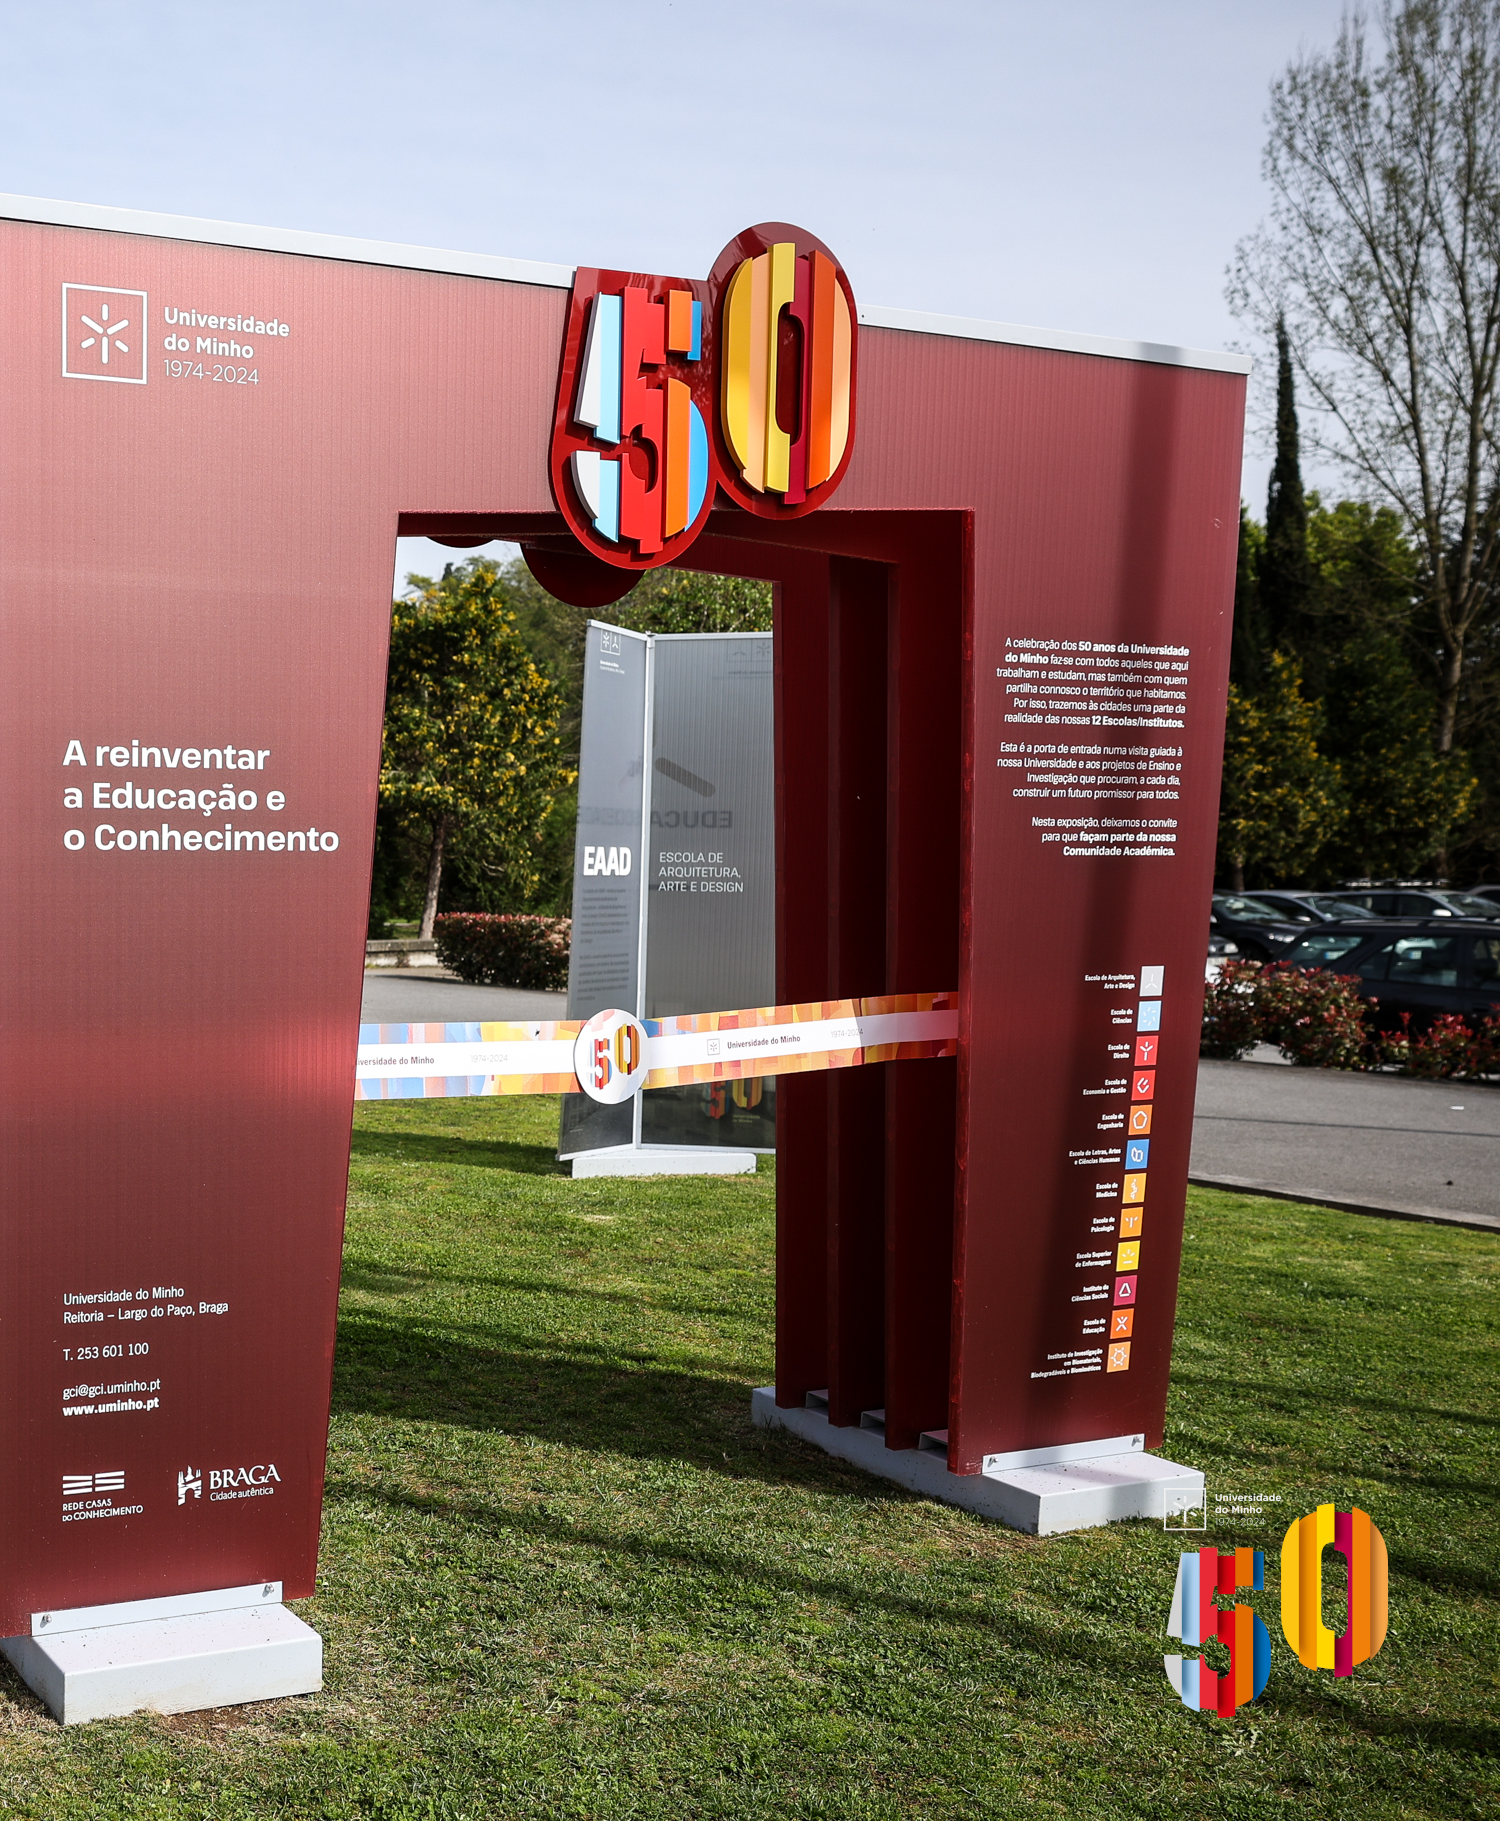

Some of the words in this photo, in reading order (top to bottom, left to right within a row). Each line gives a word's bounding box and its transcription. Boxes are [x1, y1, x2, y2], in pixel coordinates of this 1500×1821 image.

[164, 307, 290, 337] Universidade
[164, 333, 189, 352] do
[196, 336, 254, 358] Minho
[164, 359, 259, 385] 1974-2024
[571, 242, 852, 554] 50
[1005, 637, 1012, 647] A
[1013, 638, 1060, 651] celebração
[1061, 640, 1077, 650] dos
[1078, 641, 1092, 651] 50
[1092, 644, 1116, 652] anos
[1117, 643, 1129, 653] da
[1131, 644, 1190, 656] Universidade
[1005, 652, 1018, 662] do
[1019, 653, 1049, 664] Minho
[1050, 654, 1074, 665] faz-se
[1075, 657, 1095, 666] com
[1096, 657, 1120, 667] todos
[1121, 659, 1153, 669] aqueles
[1154, 661, 1170, 671] que
[1171, 661, 1189, 672] aqui
[1006, 683, 1038, 694] partilha
[1039, 686, 1081, 695] connosco
[1082, 687, 1088, 695] o
[1089, 686, 1125, 696] território
[1126, 689, 1142, 699] que
[1143, 688, 1187, 699] habitamos.
[1014, 698, 1028, 708] Por
[1029, 698, 1047, 709] isso,
[1048, 700, 1087, 710] trazemos
[1088, 700, 1098, 710] às
[1099, 701, 1132, 711] cidades
[1133, 704, 1152, 712] uma
[1153, 704, 1174, 714] parte
[1175, 704, 1186, 714] da
[1004, 713, 1043, 723] realidade
[1044, 714, 1060, 724] das
[1061, 716, 1090, 725] nossas
[1091, 715, 1102, 725] 12
[1102, 716, 1185, 728] Escolas/Institutos.
[63, 740, 87, 766] A
[96, 739, 270, 770] reinventar
[1000, 742, 1018, 752] Esta
[1019, 742, 1025, 753] é
[1026, 744, 1032, 753] a
[1033, 744, 1056, 754] porta
[1057, 743, 1069, 754] de
[1070, 745, 1102, 754] entrada
[1103, 747, 1127, 755] numa
[1128, 746, 1148, 755] visita
[1149, 747, 1176, 758] guiada
[1177, 746, 1183, 757] à
[997, 759, 1022, 767] nossa
[1024, 758, 1077, 768] Universidade
[1078, 760, 1084, 769] e
[1085, 761, 1101, 769] aos
[1102, 760, 1135, 771] projetos
[1136, 760, 1147, 770] de
[1148, 761, 1175, 770] Ensino
[1176, 763, 1182, 771] e
[1027, 773, 1078, 785] Investigação
[1079, 775, 1096, 785] que
[1097, 776, 1138, 785] procuram,
[1139, 776, 1145, 784] a
[1146, 775, 1166, 785] cada
[1167, 775, 1181, 785] dia,
[63, 787, 83, 808] a
[93, 781, 258, 816] Educação
[266, 790, 286, 811] e
[1032, 817, 1055, 827] Nesta
[1057, 817, 1100, 829] exposição,
[1101, 818, 1140, 827] deixamos
[1141, 819, 1147, 827] o
[1148, 818, 1178, 828] convite
[63, 828, 85, 850] o
[94, 823, 340, 851] Conhecimento
[1041, 833, 1060, 843] para
[1061, 833, 1078, 843] que
[1079, 831, 1109, 843] façam
[1110, 833, 1135, 843] parte
[1136, 832, 1148, 842] da
[1149, 834, 1176, 842] nossa
[660, 852, 705, 862] ESCOLA
[708, 853, 723, 862] DE
[1063, 846, 1122, 856] Comunidade
[1123, 846, 1175, 856] Académica.
[583, 846, 631, 876] EAAD
[658, 867, 741, 878] ARQUITETURA,
[658, 881, 687, 892] ARTE
[691, 882, 697, 892] E
[701, 882, 743, 893] DESIGN
[830, 1028, 864, 1038] 1974-2024
[727, 1038, 769, 1049] Universidade
[771, 1037, 779, 1045] do
[780, 1035, 801, 1044] Minho
[357, 1057, 397, 1066] iversidade
[399, 1057, 409, 1065] do
[410, 1056, 435, 1064] Minho
[587, 1023, 640, 1090] 50
[63, 1289, 132, 1305] Universidade
[135, 1288, 149, 1300] do
[152, 1286, 184, 1299] Minho
[63, 1311, 104, 1324] Reitoria
[118, 1307, 148, 1321] Largo
[150, 1305, 164, 1317] do
[167, 1304, 195, 1318] Paço,
[199, 1301, 228, 1314] Braga
[63, 1349, 73, 1361] T.
[77, 1347, 99, 1360] 253
[102, 1345, 123, 1358] 601
[128, 1343, 149, 1356] 100
[63, 1378, 160, 1400] gci@gci.uminho.pt
[63, 1397, 159, 1416] www.uminho.pt
[209, 1464, 281, 1490] BRAGA
[210, 1489, 237, 1501] Cidade
[238, 1486, 274, 1499] autêntica
[62, 1501, 84, 1511] REDE
[85, 1499, 111, 1509] CASAS
[62, 1514, 73, 1522] DO
[73, 1505, 143, 1521] CONHECIMENTO
